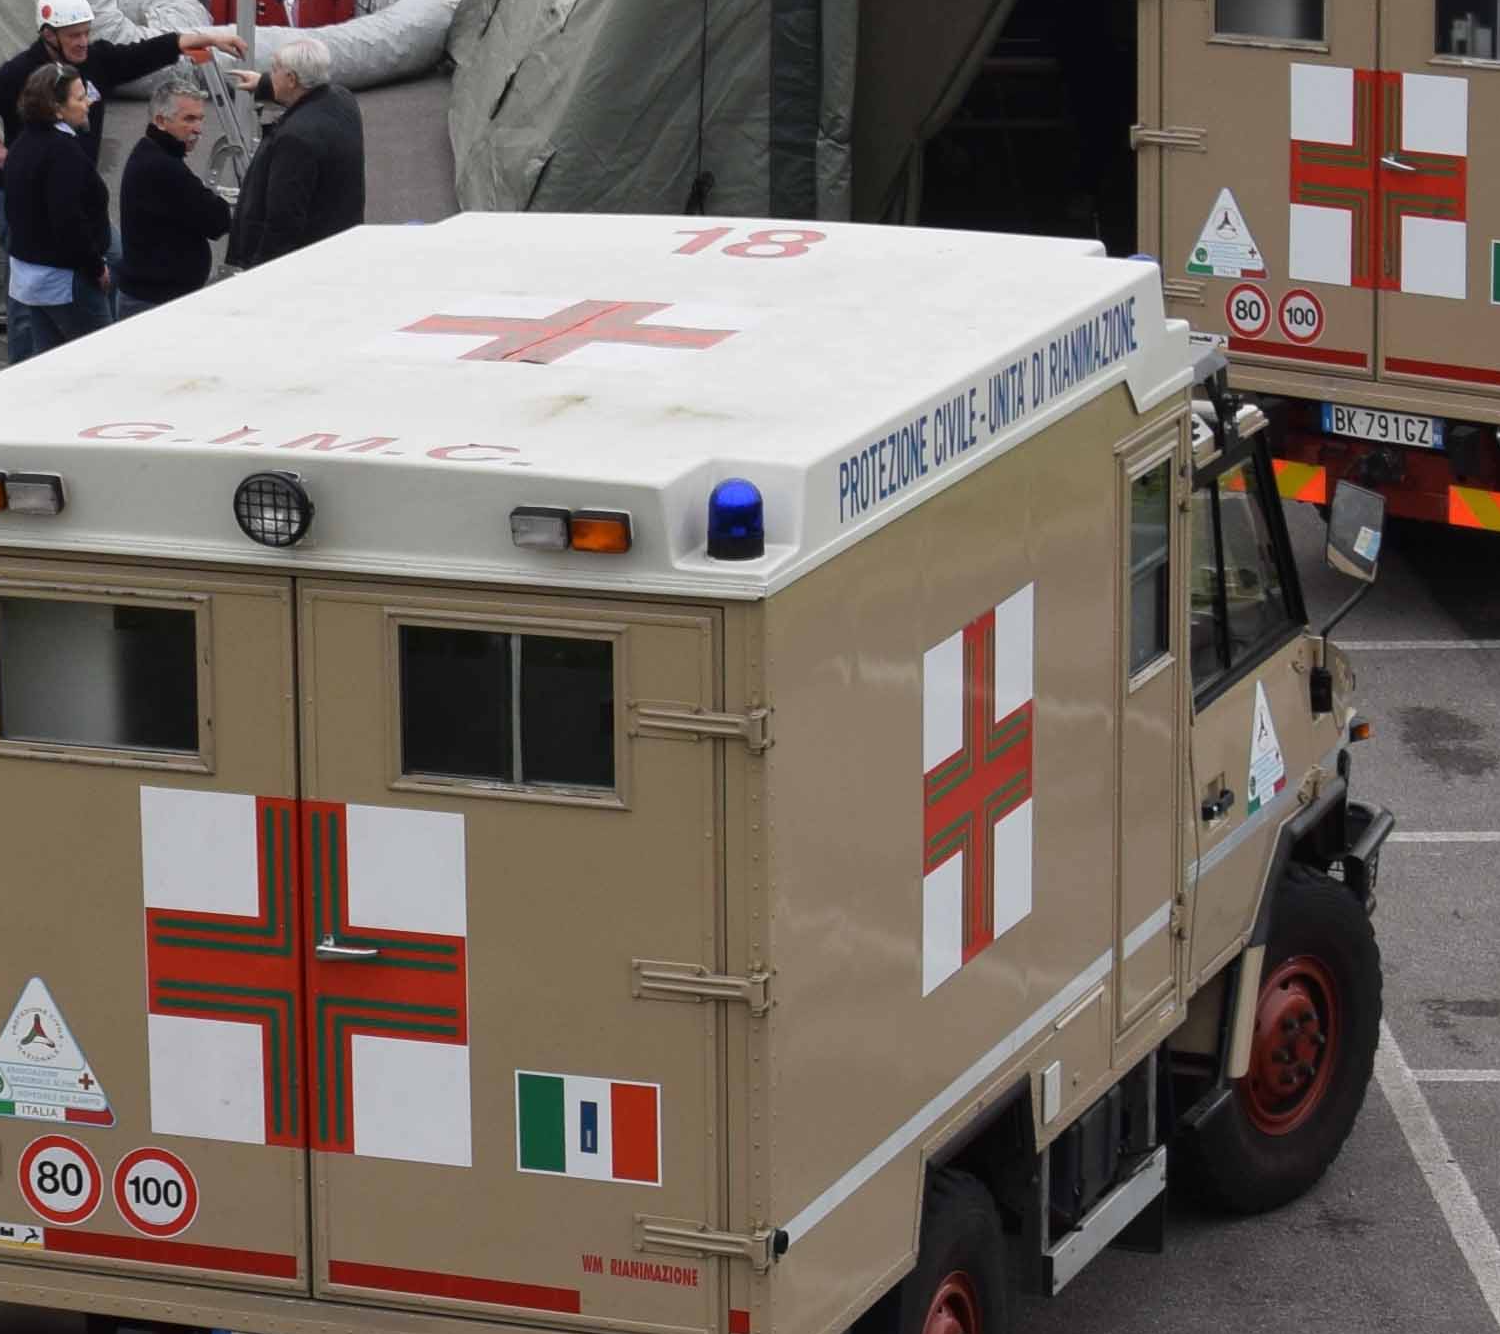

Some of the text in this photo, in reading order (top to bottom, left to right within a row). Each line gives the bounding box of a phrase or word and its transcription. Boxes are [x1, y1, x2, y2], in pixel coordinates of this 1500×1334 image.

[670, 226, 827, 258] 18
[1235, 298, 1262, 322] 80
[1285, 306, 1317, 327] 100
[839, 415, 929, 524] PROTEZIONE
[933, 387, 977, 467] CIVILE
[988, 357, 1028, 436] UNITA'
[1031, 347, 1046, 410] DI
[1049, 295, 1138, 399] RIANIMAZIONE
[77, 420, 535, 466] G.I.M.C.
[21, 1104, 59, 1118] ITALIA
[36, 1160, 83, 1197] 80
[128, 1175, 183, 1209] 100
[582, 1253, 698, 1287] WM RIANIMAZIONE
